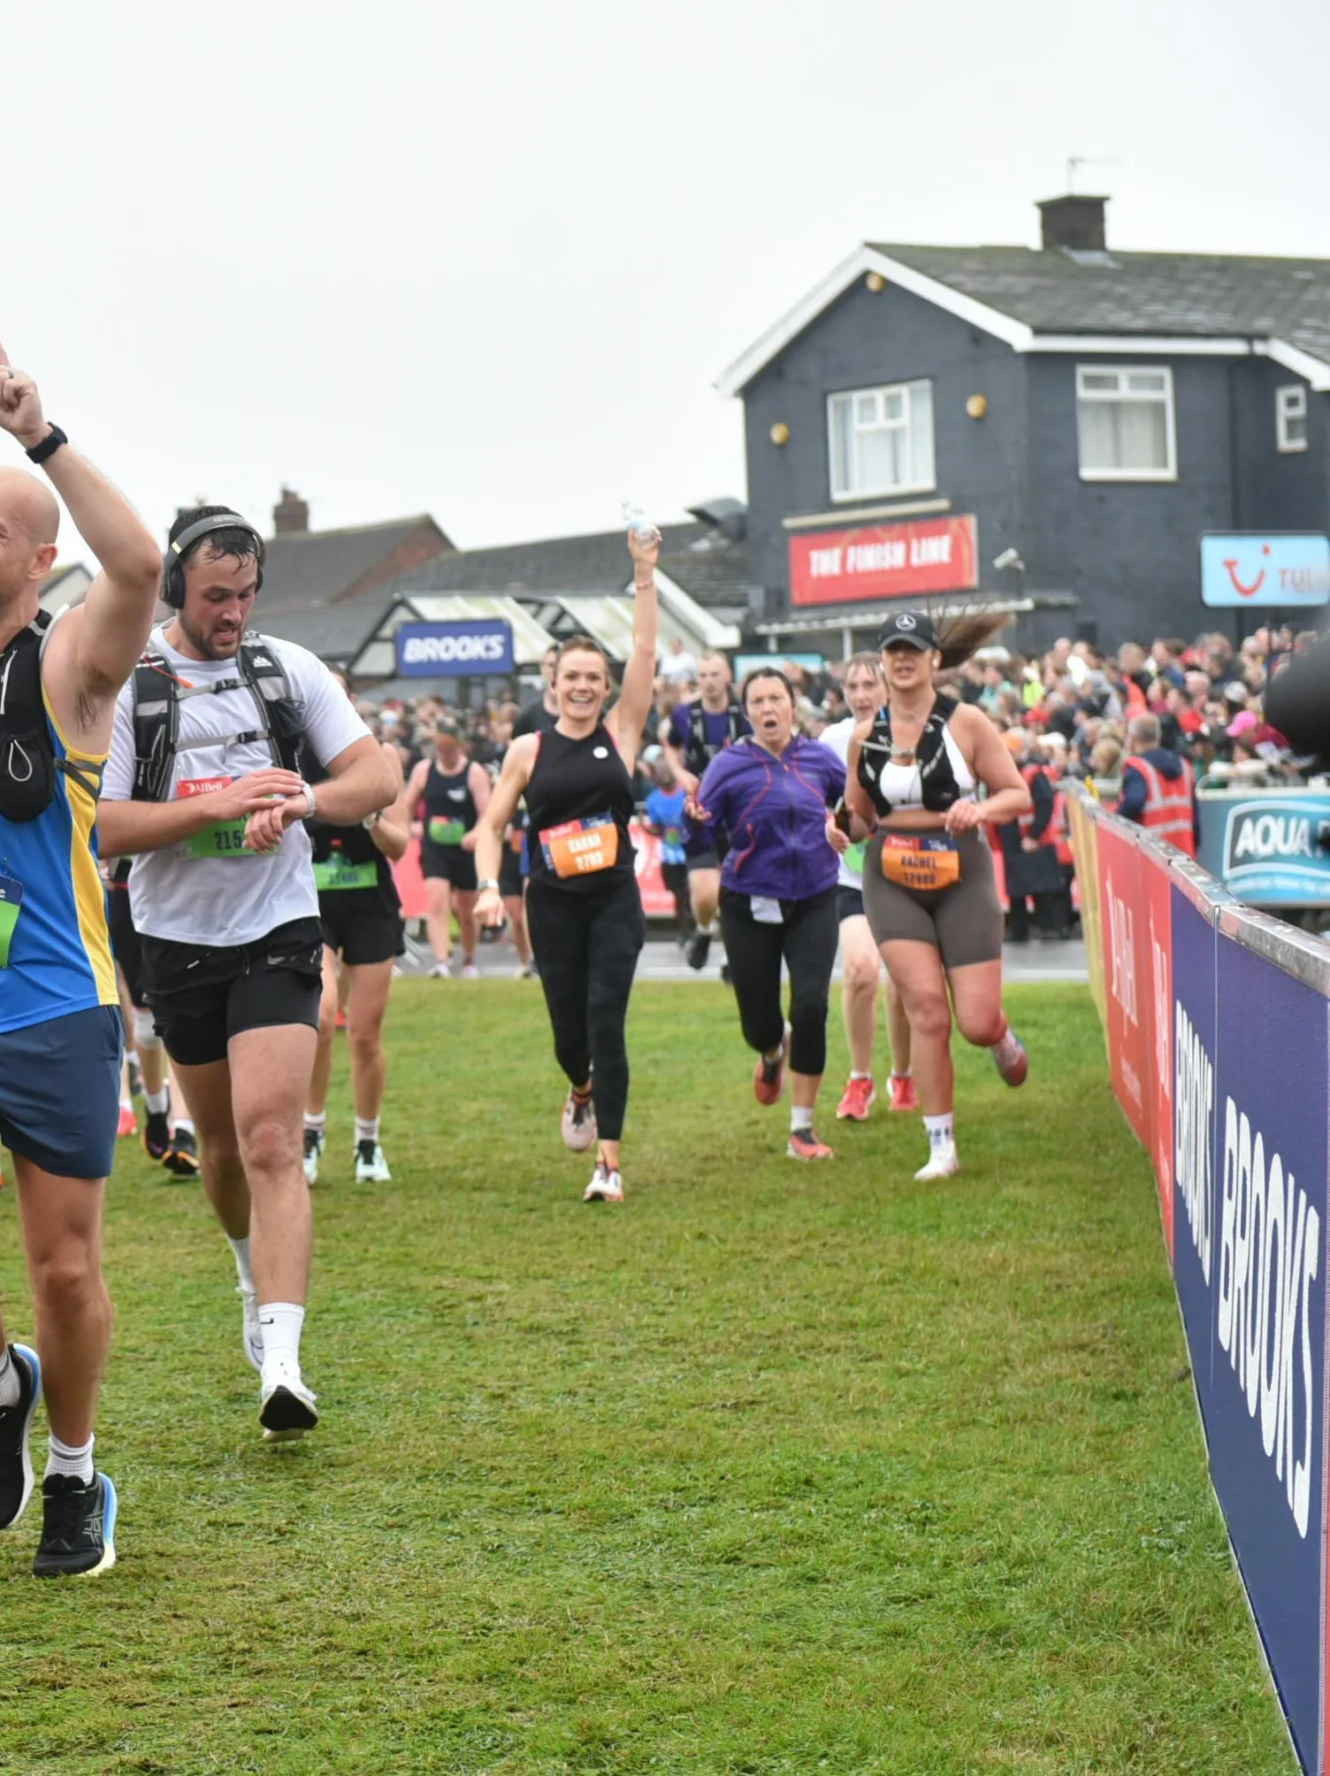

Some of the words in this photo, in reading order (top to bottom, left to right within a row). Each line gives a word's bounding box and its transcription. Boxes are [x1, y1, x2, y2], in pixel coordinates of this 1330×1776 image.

[809, 547, 842, 578] THE
[846, 540, 906, 574] FINISH
[910, 534, 951, 568] LINE
[404, 634, 505, 664] BROOKS
[215, 830, 244, 850] 215
[1235, 815, 1313, 858] AQUA
[1176, 999, 1213, 1286] BROOKS
[1219, 1094, 1320, 1539] BROOKS
